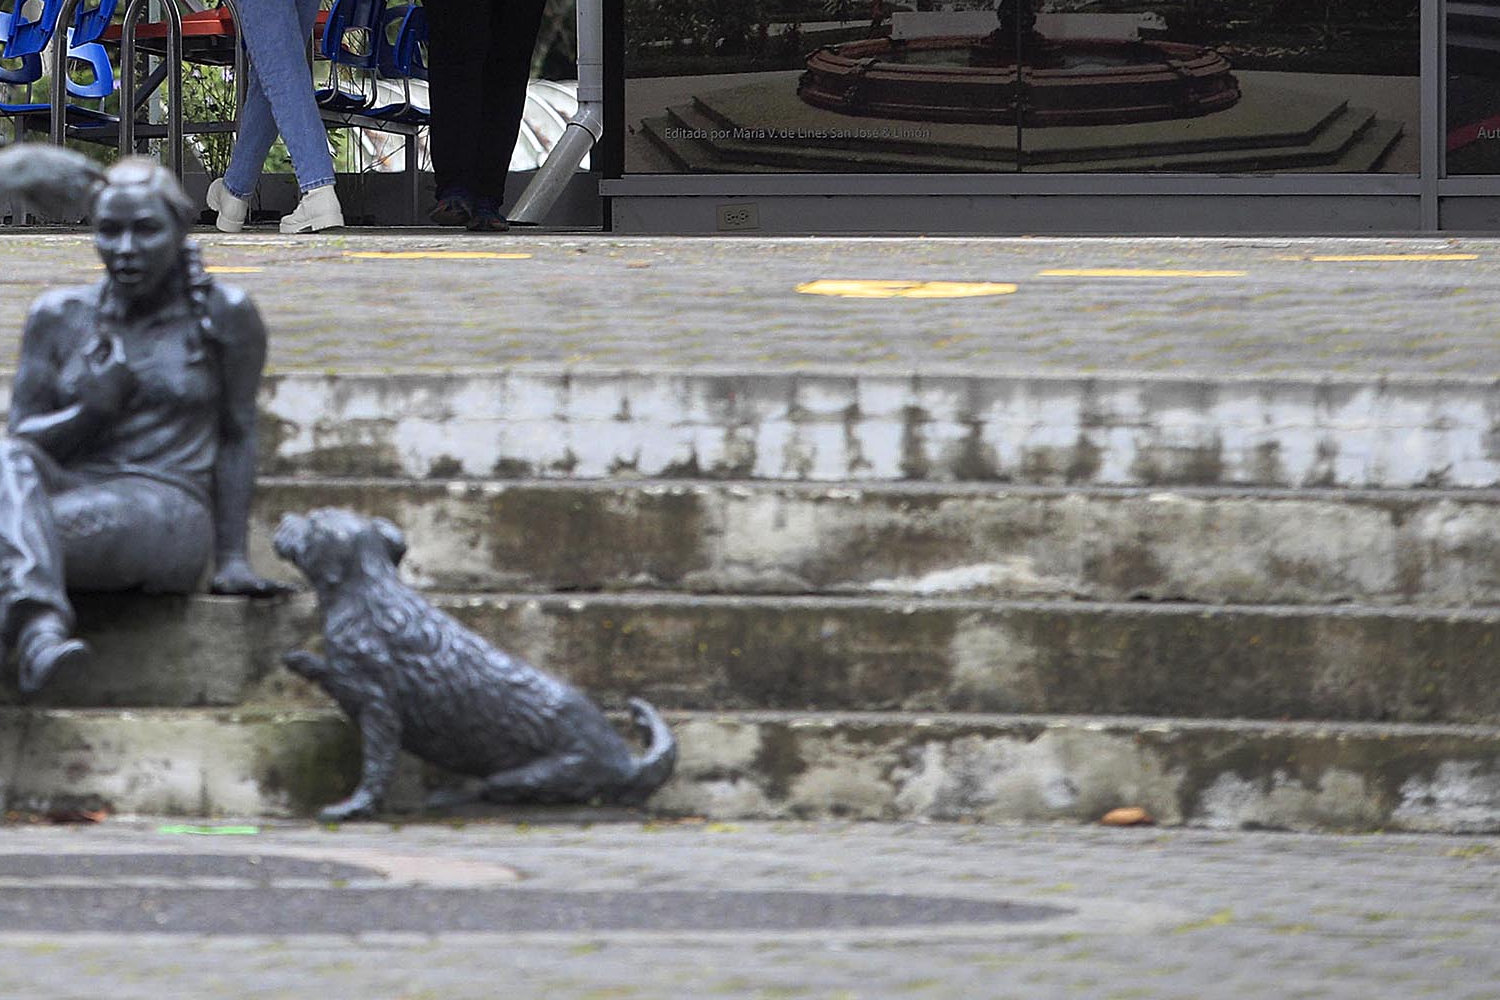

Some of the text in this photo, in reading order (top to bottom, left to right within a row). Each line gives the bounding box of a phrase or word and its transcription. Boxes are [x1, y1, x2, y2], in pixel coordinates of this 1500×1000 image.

[665, 127, 707, 139] Editada
[711, 130, 730, 141] por
[767, 127, 778, 139] V.
[780, 127, 795, 139] de
[830, 127, 852, 139] San
[854, 127, 879, 139] José
